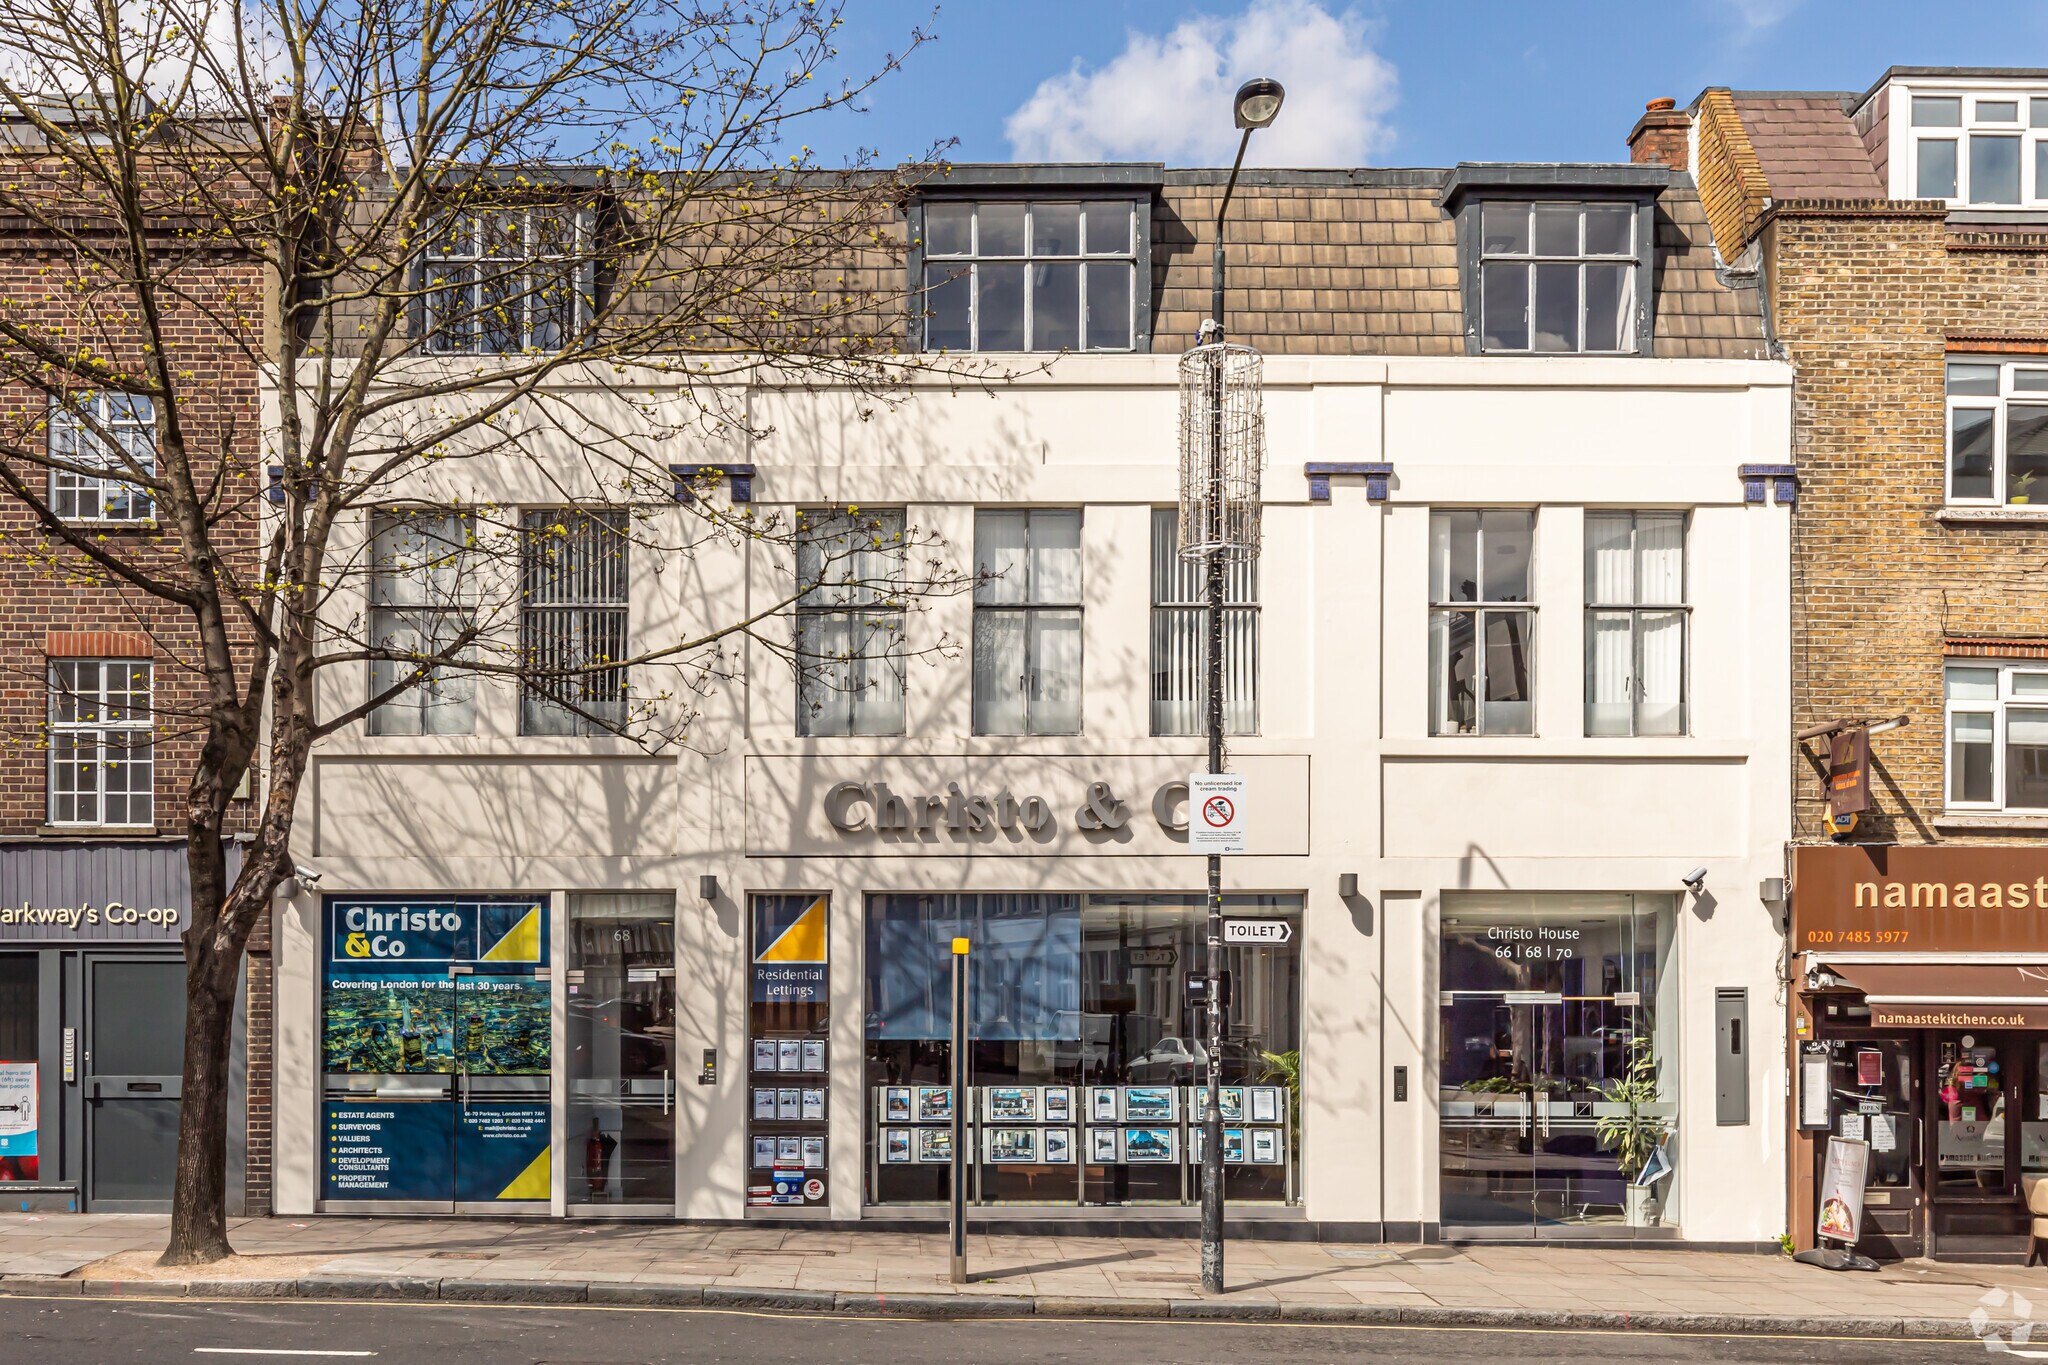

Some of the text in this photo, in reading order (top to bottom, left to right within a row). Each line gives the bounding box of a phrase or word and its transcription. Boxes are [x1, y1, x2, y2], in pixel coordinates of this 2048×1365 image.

[824, 781, 1190, 831] Christo & C
[0, 902, 178, 929] arkway's Co-op
[345, 907, 462, 932] Christo
[614, 930, 631, 942] 68
[1229, 926, 1276, 936] TOILET
[1487, 927, 1580, 940] Christo House
[1808, 931, 1909, 943] 020 7485 5977
[1495, 946, 1512, 958] 66
[1525, 946, 1542, 958] 68
[1556, 948, 1572, 960] 70
[757, 968, 823, 981] Residential
[332, 980, 523, 992] Covering London for the last 30 years.
[766, 984, 814, 998] Lettings
[1878, 1013, 2025, 1026] namaastekitchen.co.uk
